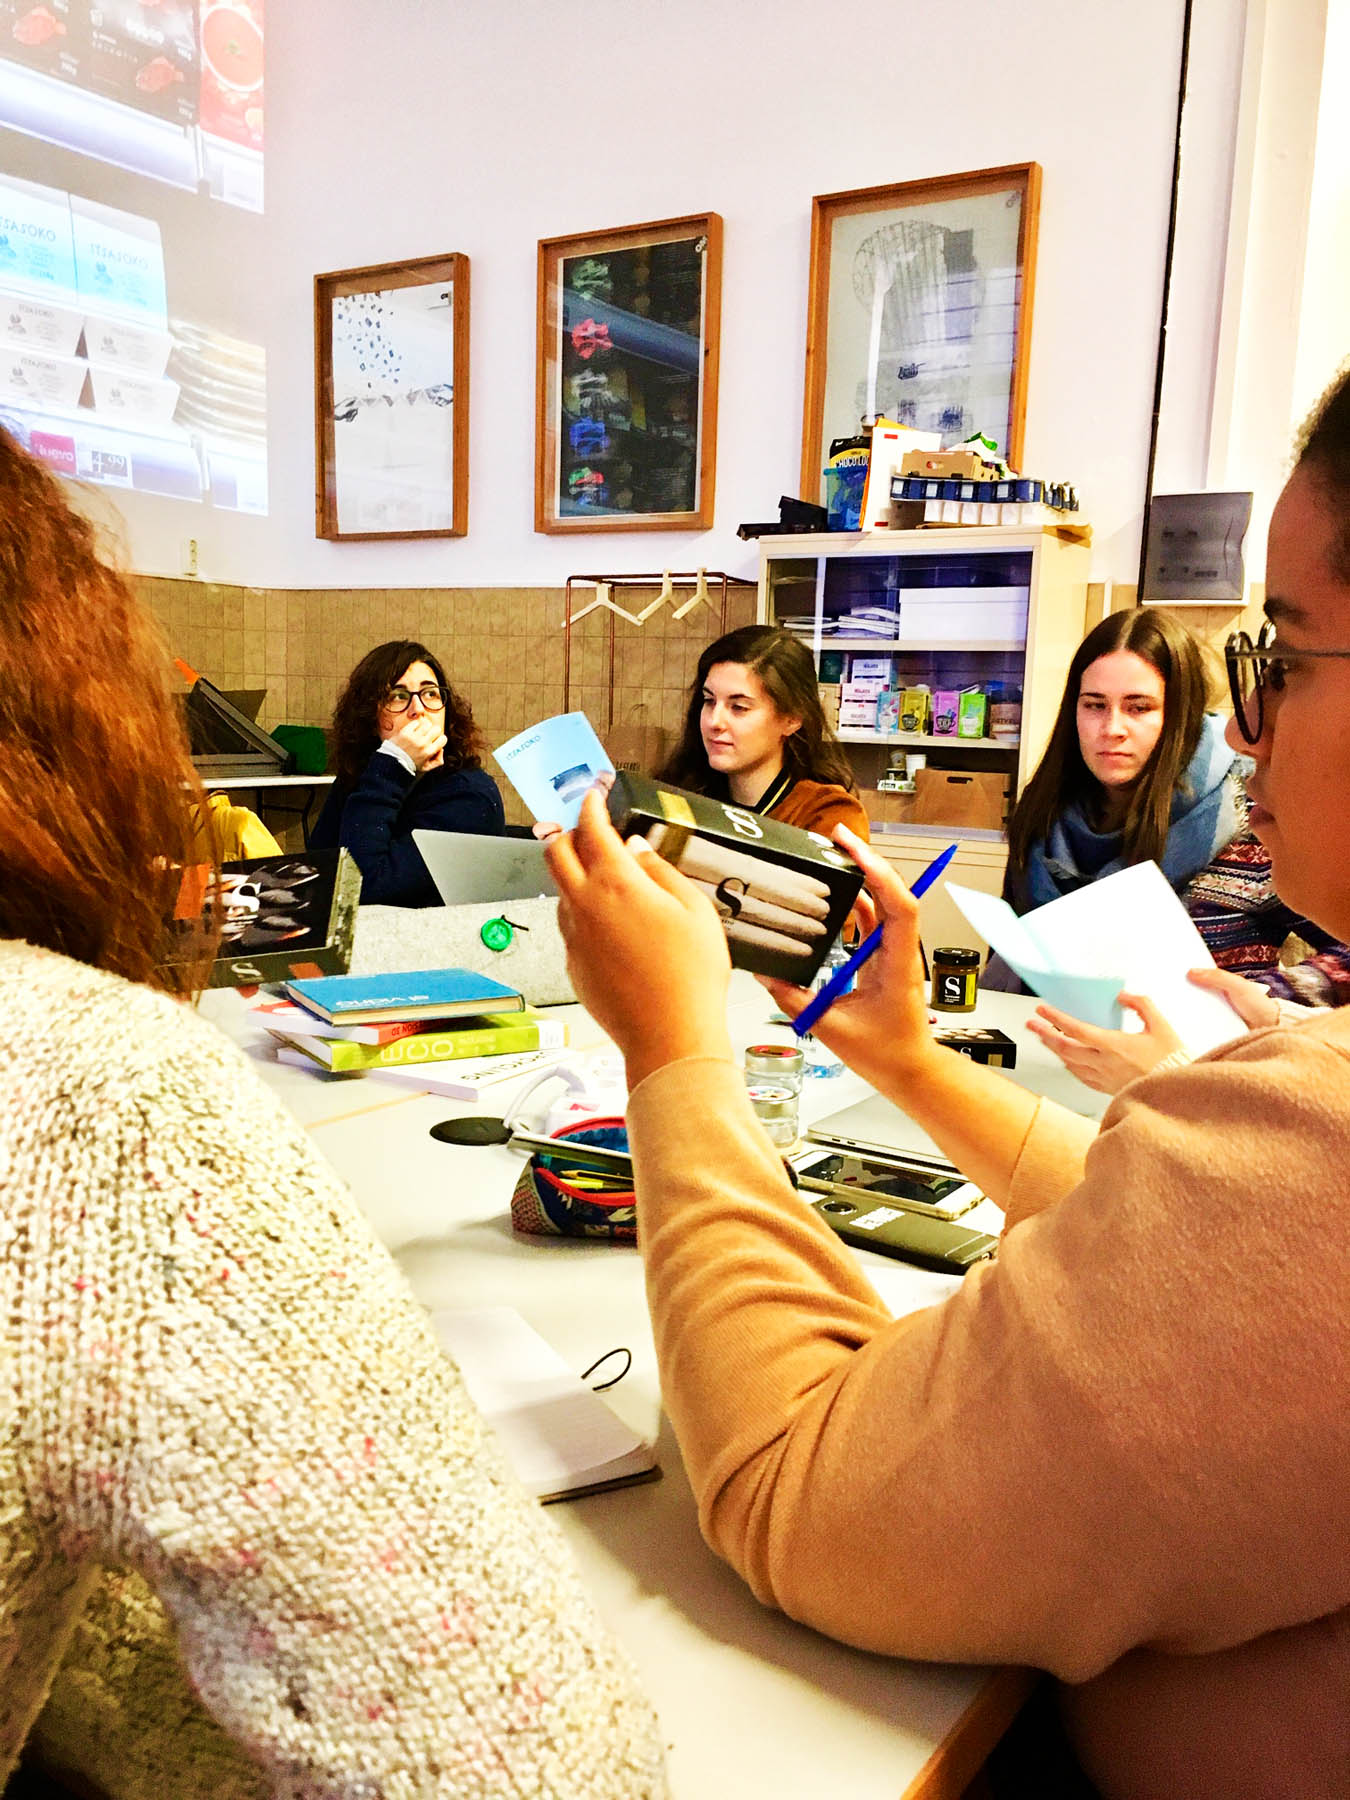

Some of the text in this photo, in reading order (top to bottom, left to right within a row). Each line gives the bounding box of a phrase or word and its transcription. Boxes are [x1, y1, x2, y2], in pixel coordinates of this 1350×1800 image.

[230, 882, 262, 915] S
[716, 877, 750, 917] S
[231, 963, 264, 982] S
[945, 976, 961, 996] S
